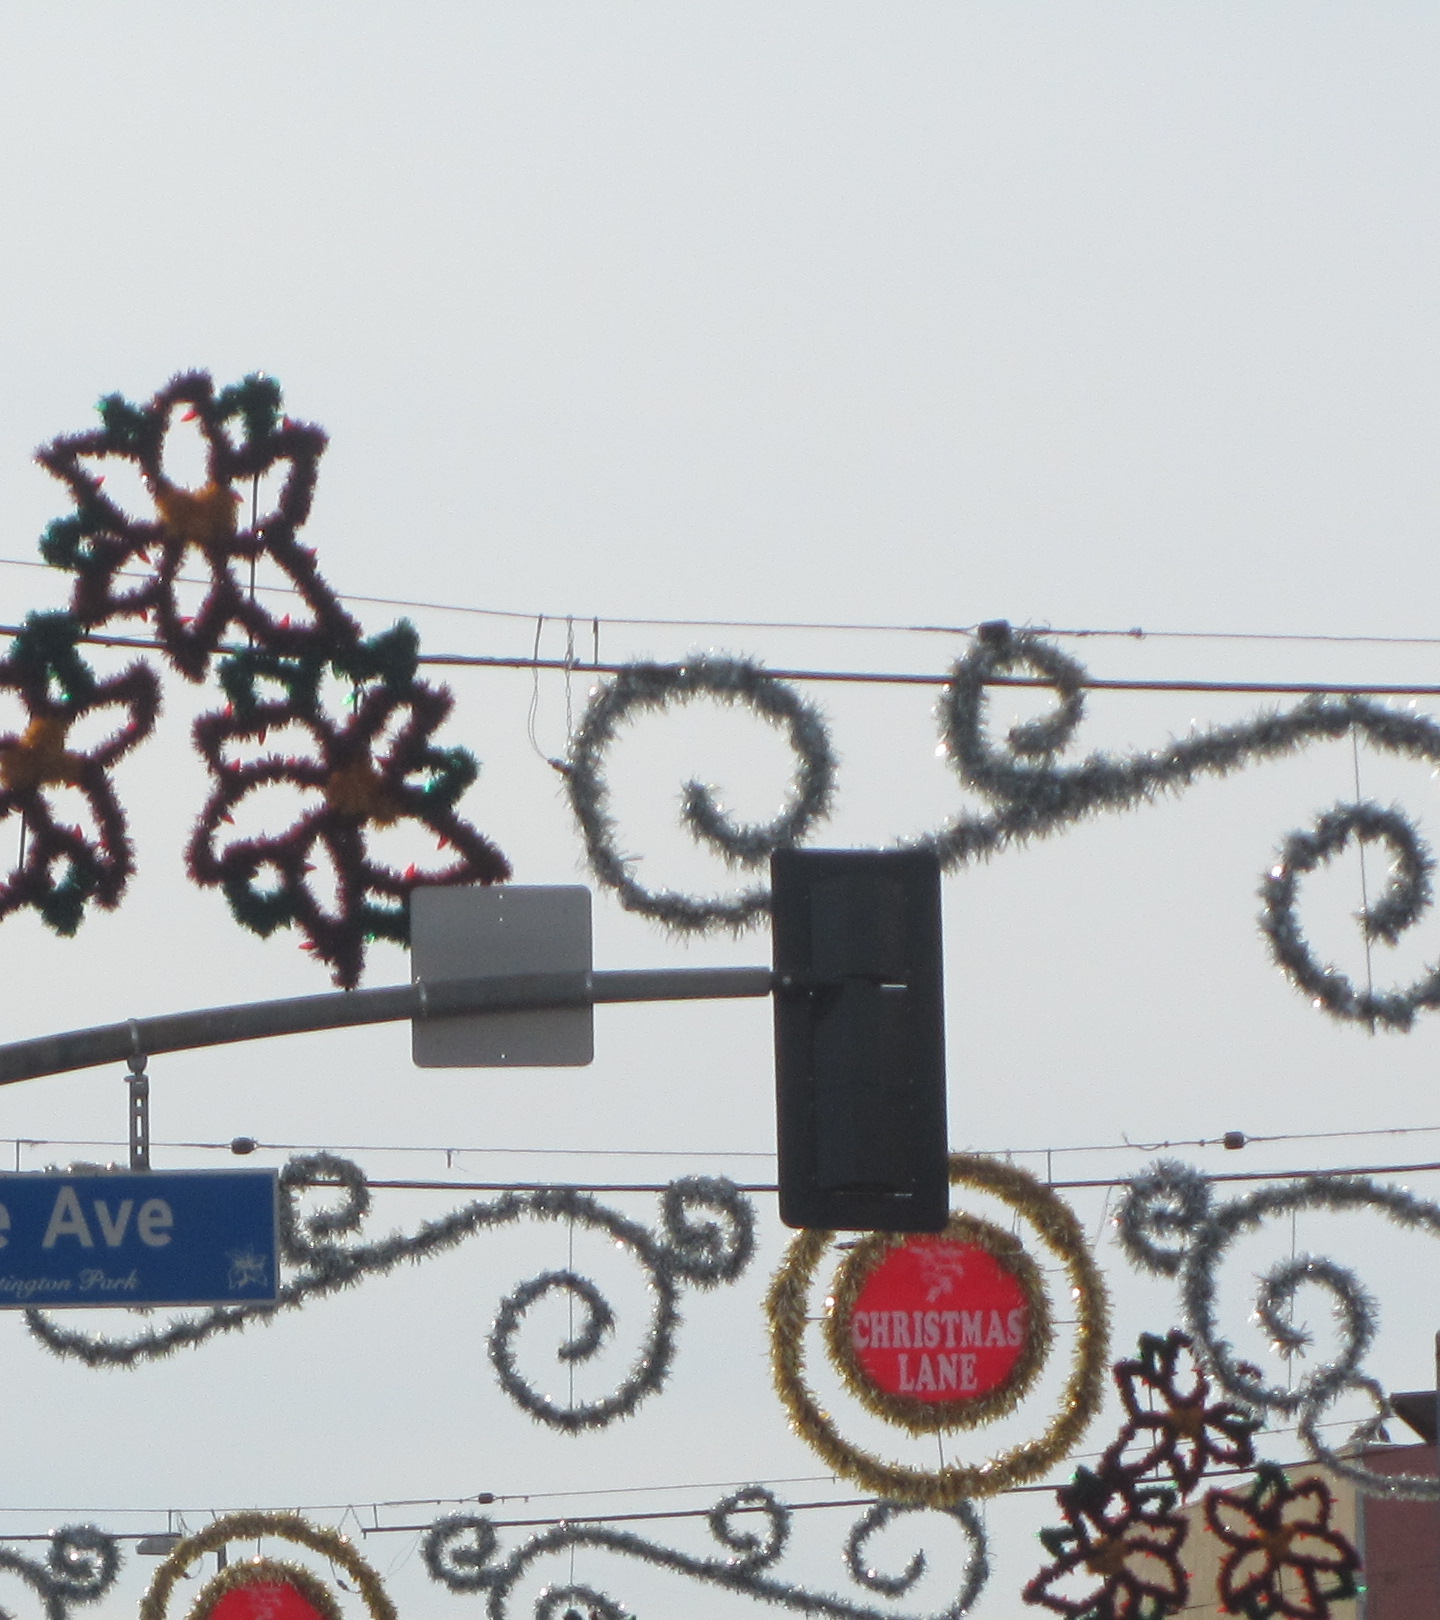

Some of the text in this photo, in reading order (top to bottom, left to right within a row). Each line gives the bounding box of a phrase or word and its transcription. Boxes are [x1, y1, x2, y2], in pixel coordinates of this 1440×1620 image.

[41, 1185, 175, 1249] Ave
[76, 1269, 140, 1292] Park
[851, 1309, 1024, 1349] CHRISTMAS
[897, 1353, 978, 1392] LANE
